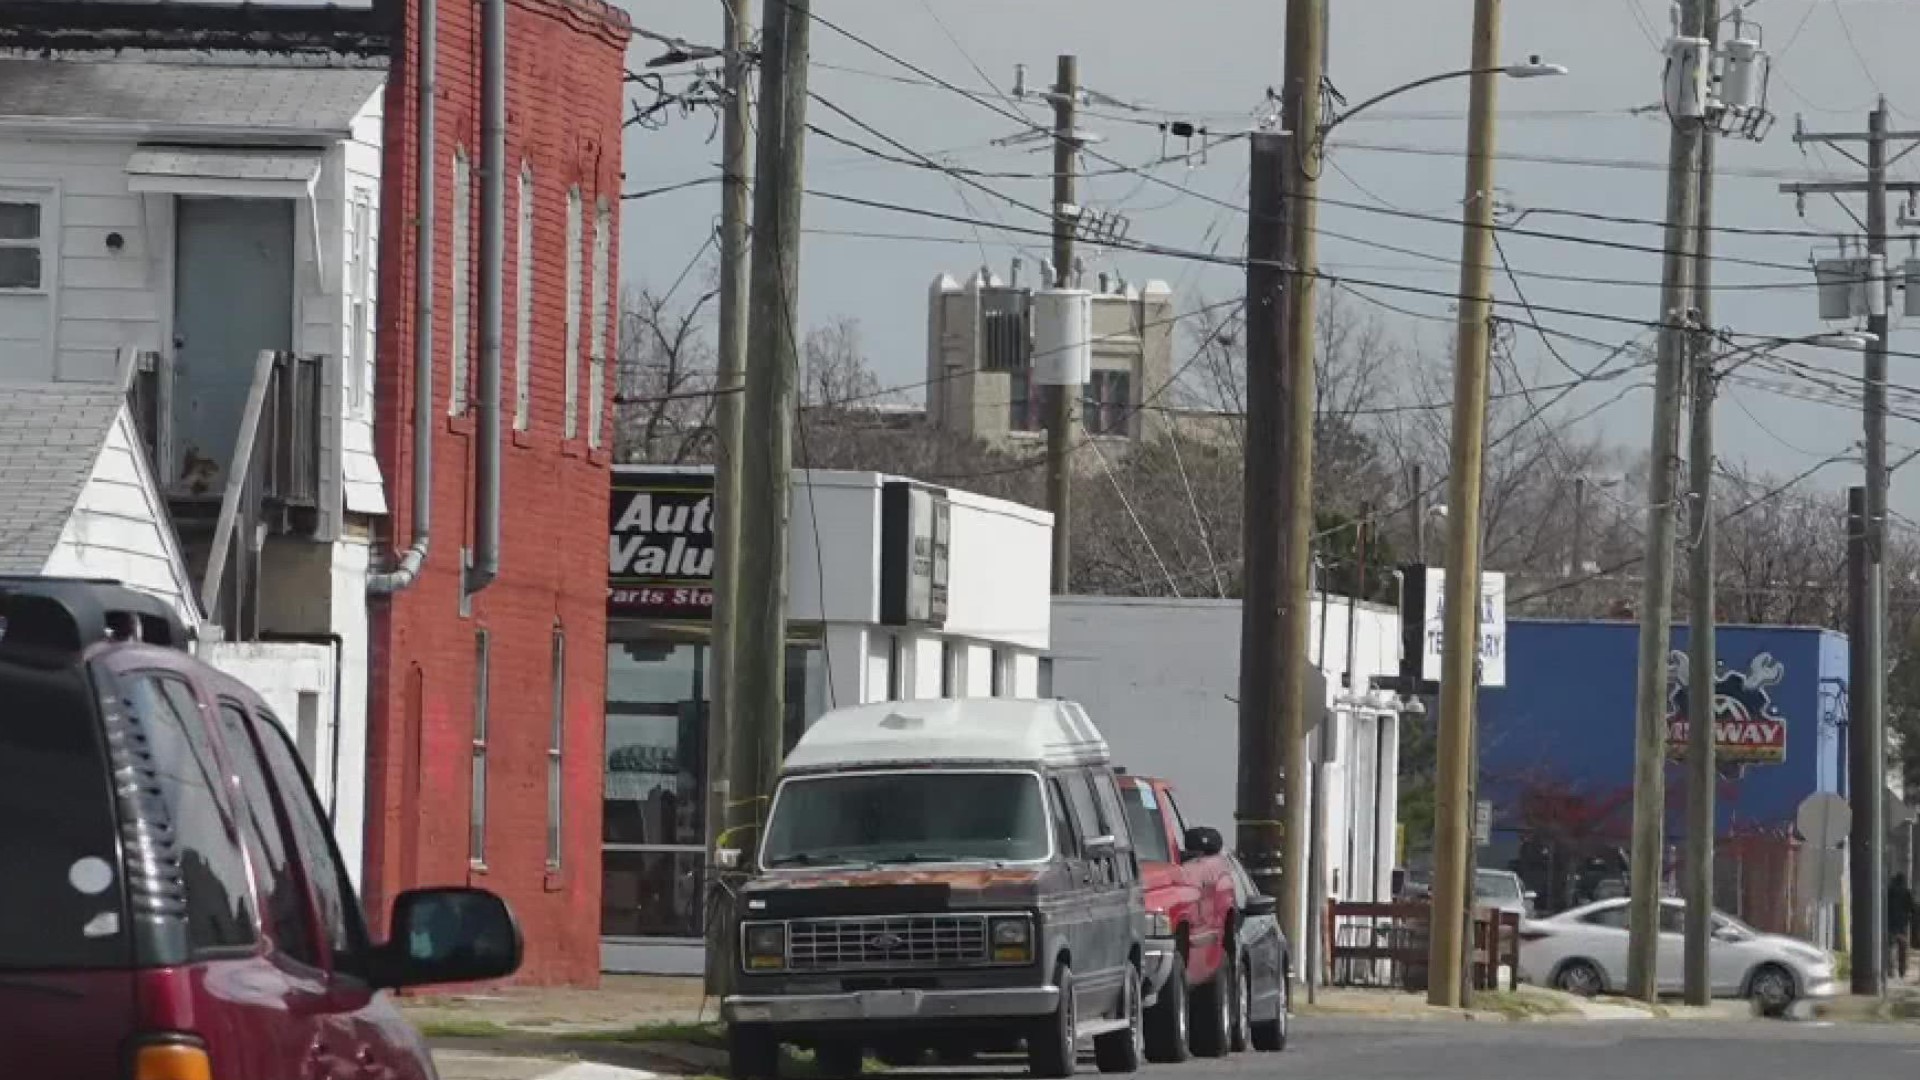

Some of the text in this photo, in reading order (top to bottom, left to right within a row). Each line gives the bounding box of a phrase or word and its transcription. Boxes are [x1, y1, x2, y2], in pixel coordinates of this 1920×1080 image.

[614, 493, 714, 533] Aut
[610, 535, 714, 575] Valu
[672, 589, 712, 606] Sto
[1666, 722, 1778, 743] MIWAY
